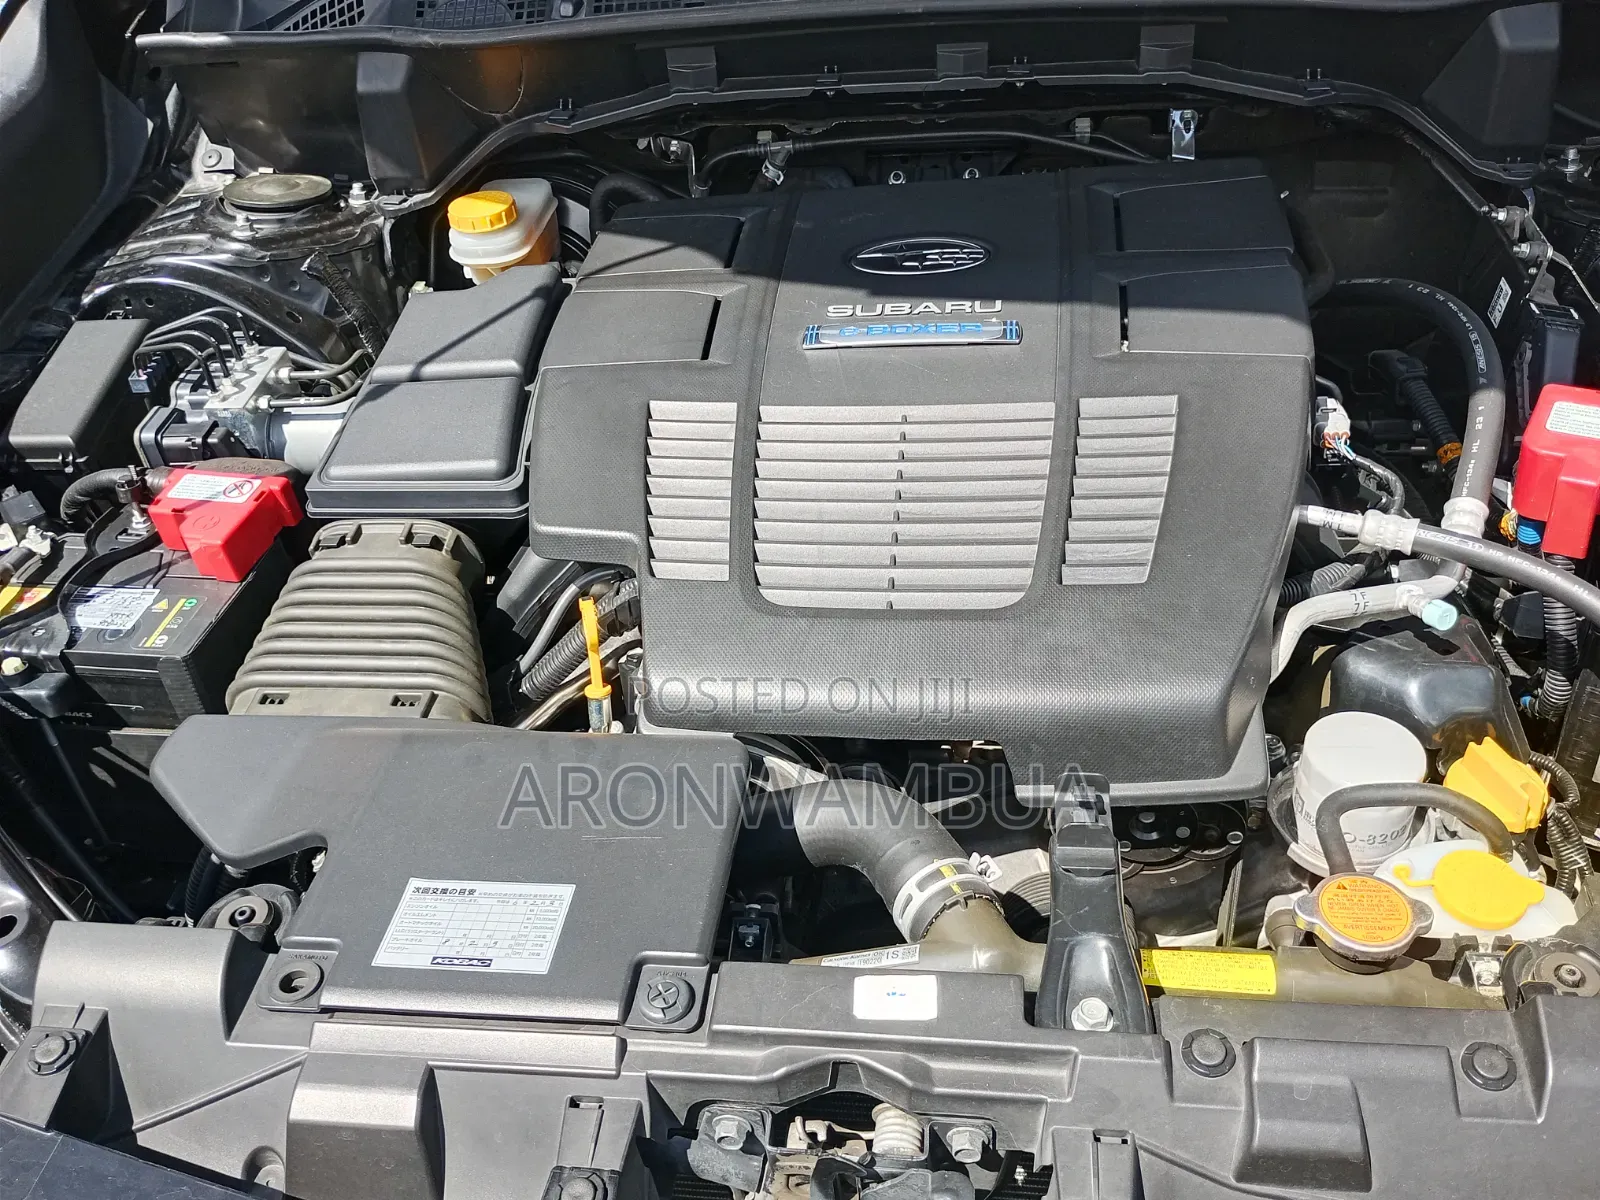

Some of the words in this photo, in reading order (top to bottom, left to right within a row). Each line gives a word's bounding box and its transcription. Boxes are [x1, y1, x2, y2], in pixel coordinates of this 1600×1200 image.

[826, 300, 1002, 317] SUBARU
[839, 322, 984, 337] e-BOXER
[1475, 416, 1484, 430] 23
[1471, 439, 1480, 453] HL
[1488, 548, 1504, 559] HP
